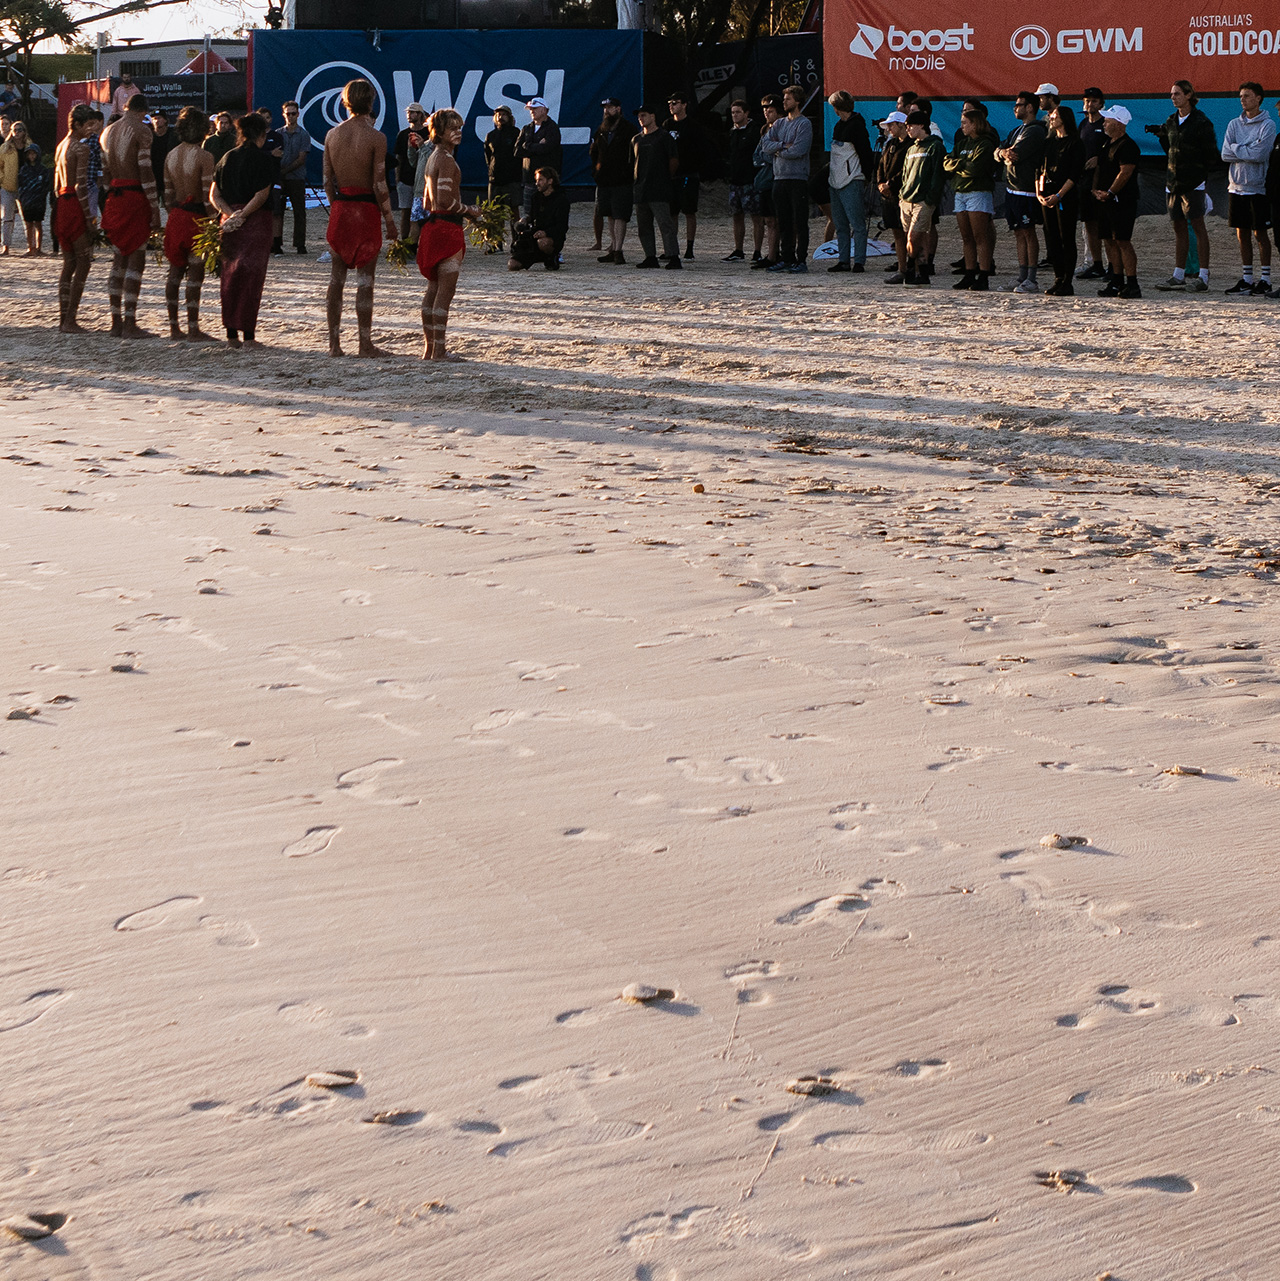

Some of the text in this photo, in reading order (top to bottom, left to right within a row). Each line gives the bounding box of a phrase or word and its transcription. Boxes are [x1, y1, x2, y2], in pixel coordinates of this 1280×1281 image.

[1189, 14, 1253, 28] AUSTRALIA'S
[888, 23, 974, 52] boost
[1056, 27, 1143, 54] GWM
[889, 54, 946, 71] mobile
[392, 69, 591, 146] WSL
